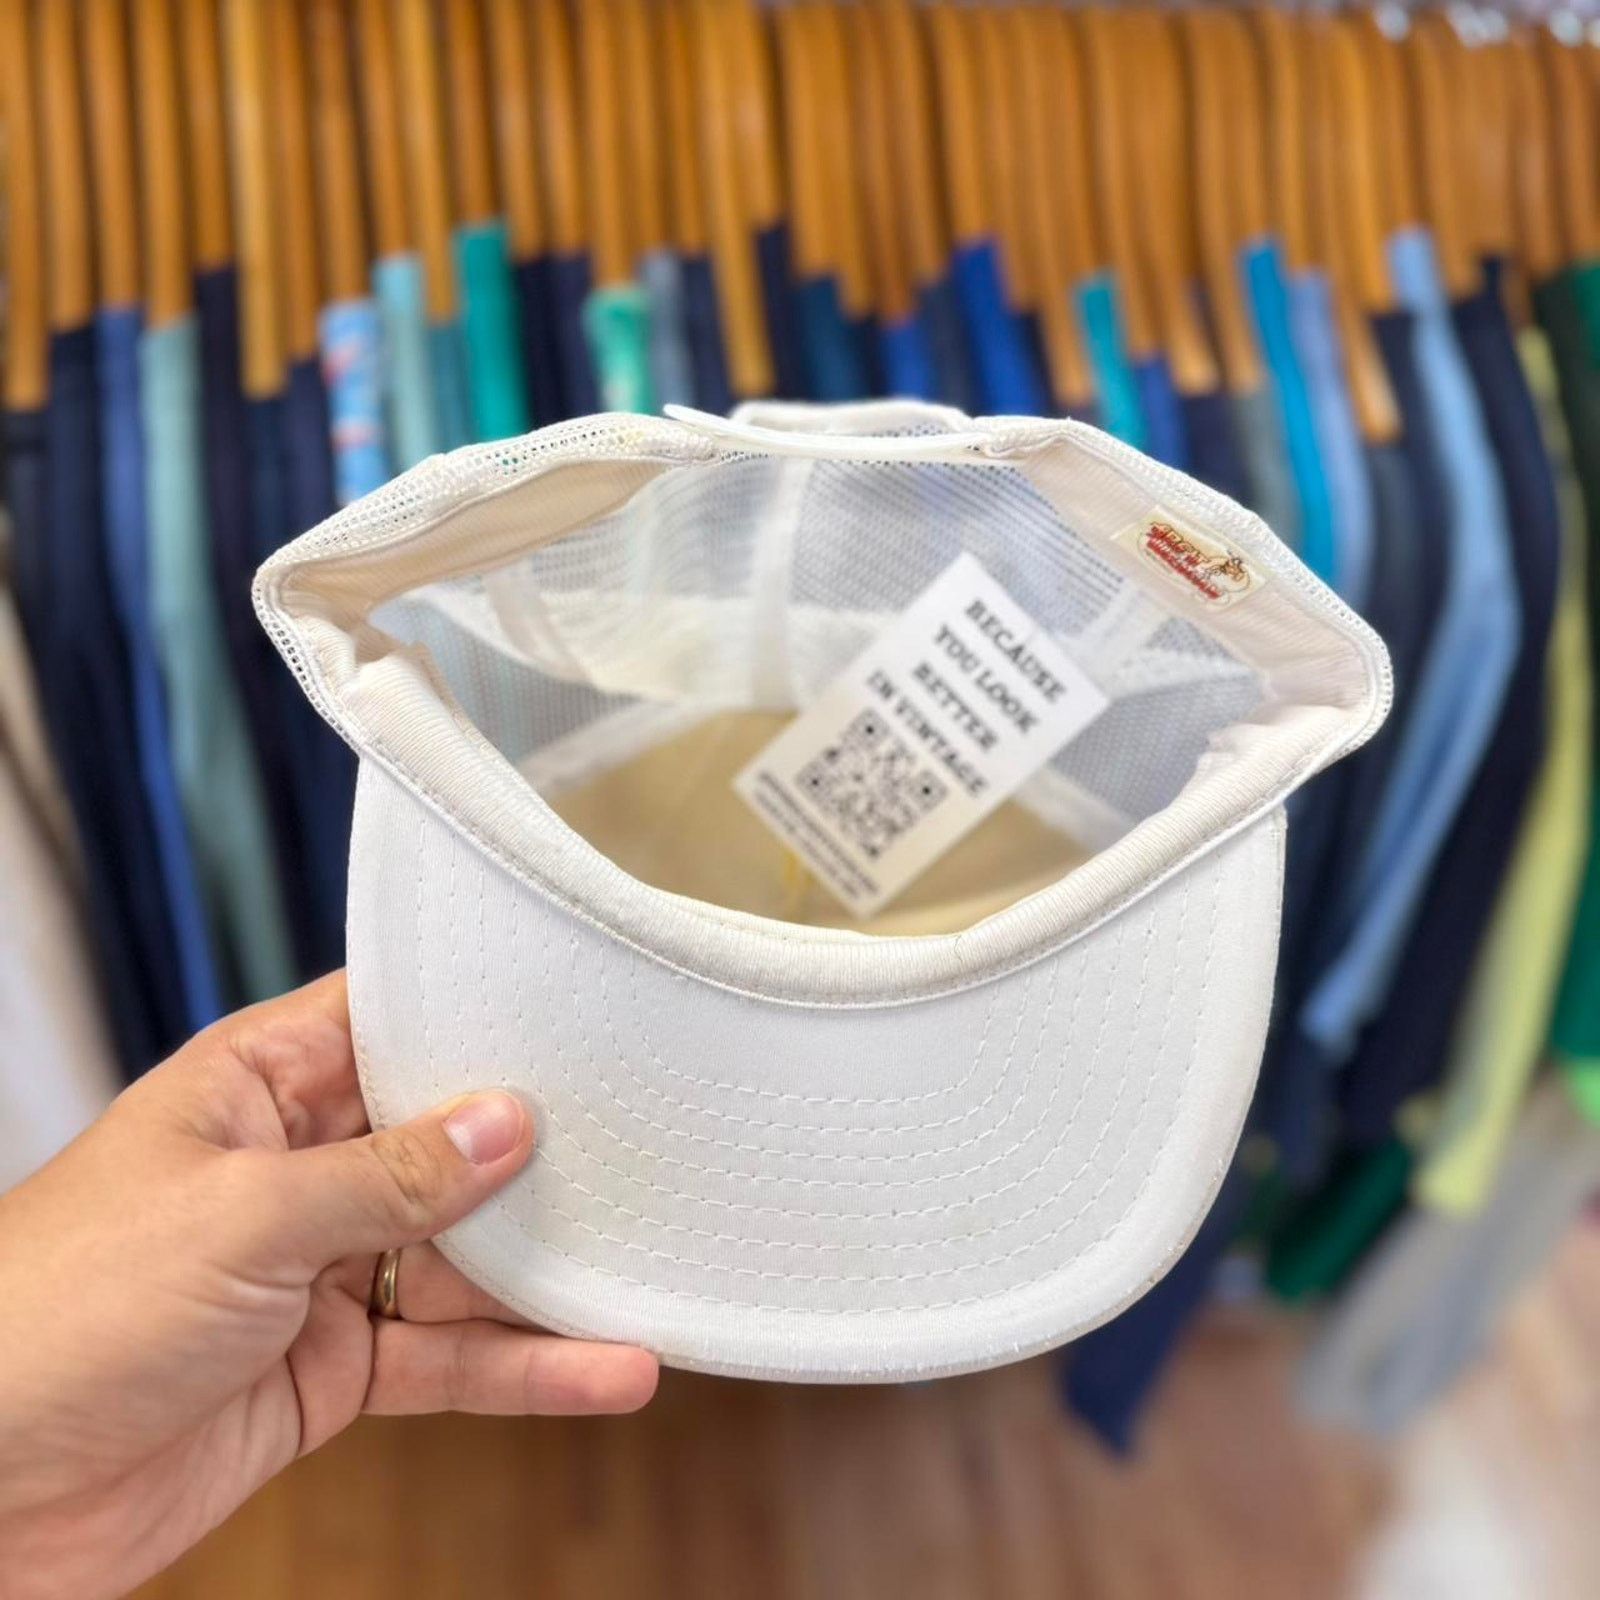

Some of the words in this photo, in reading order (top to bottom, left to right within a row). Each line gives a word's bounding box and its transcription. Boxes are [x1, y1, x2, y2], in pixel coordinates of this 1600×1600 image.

[934, 624, 978, 673] YOU
[975, 670, 1039, 734] LOOK
[965, 600, 1066, 703] BECAUSE
[866, 670, 895, 702] IN
[894, 695, 988, 796] VINTAGE
[912, 662, 997, 752] BETTER
